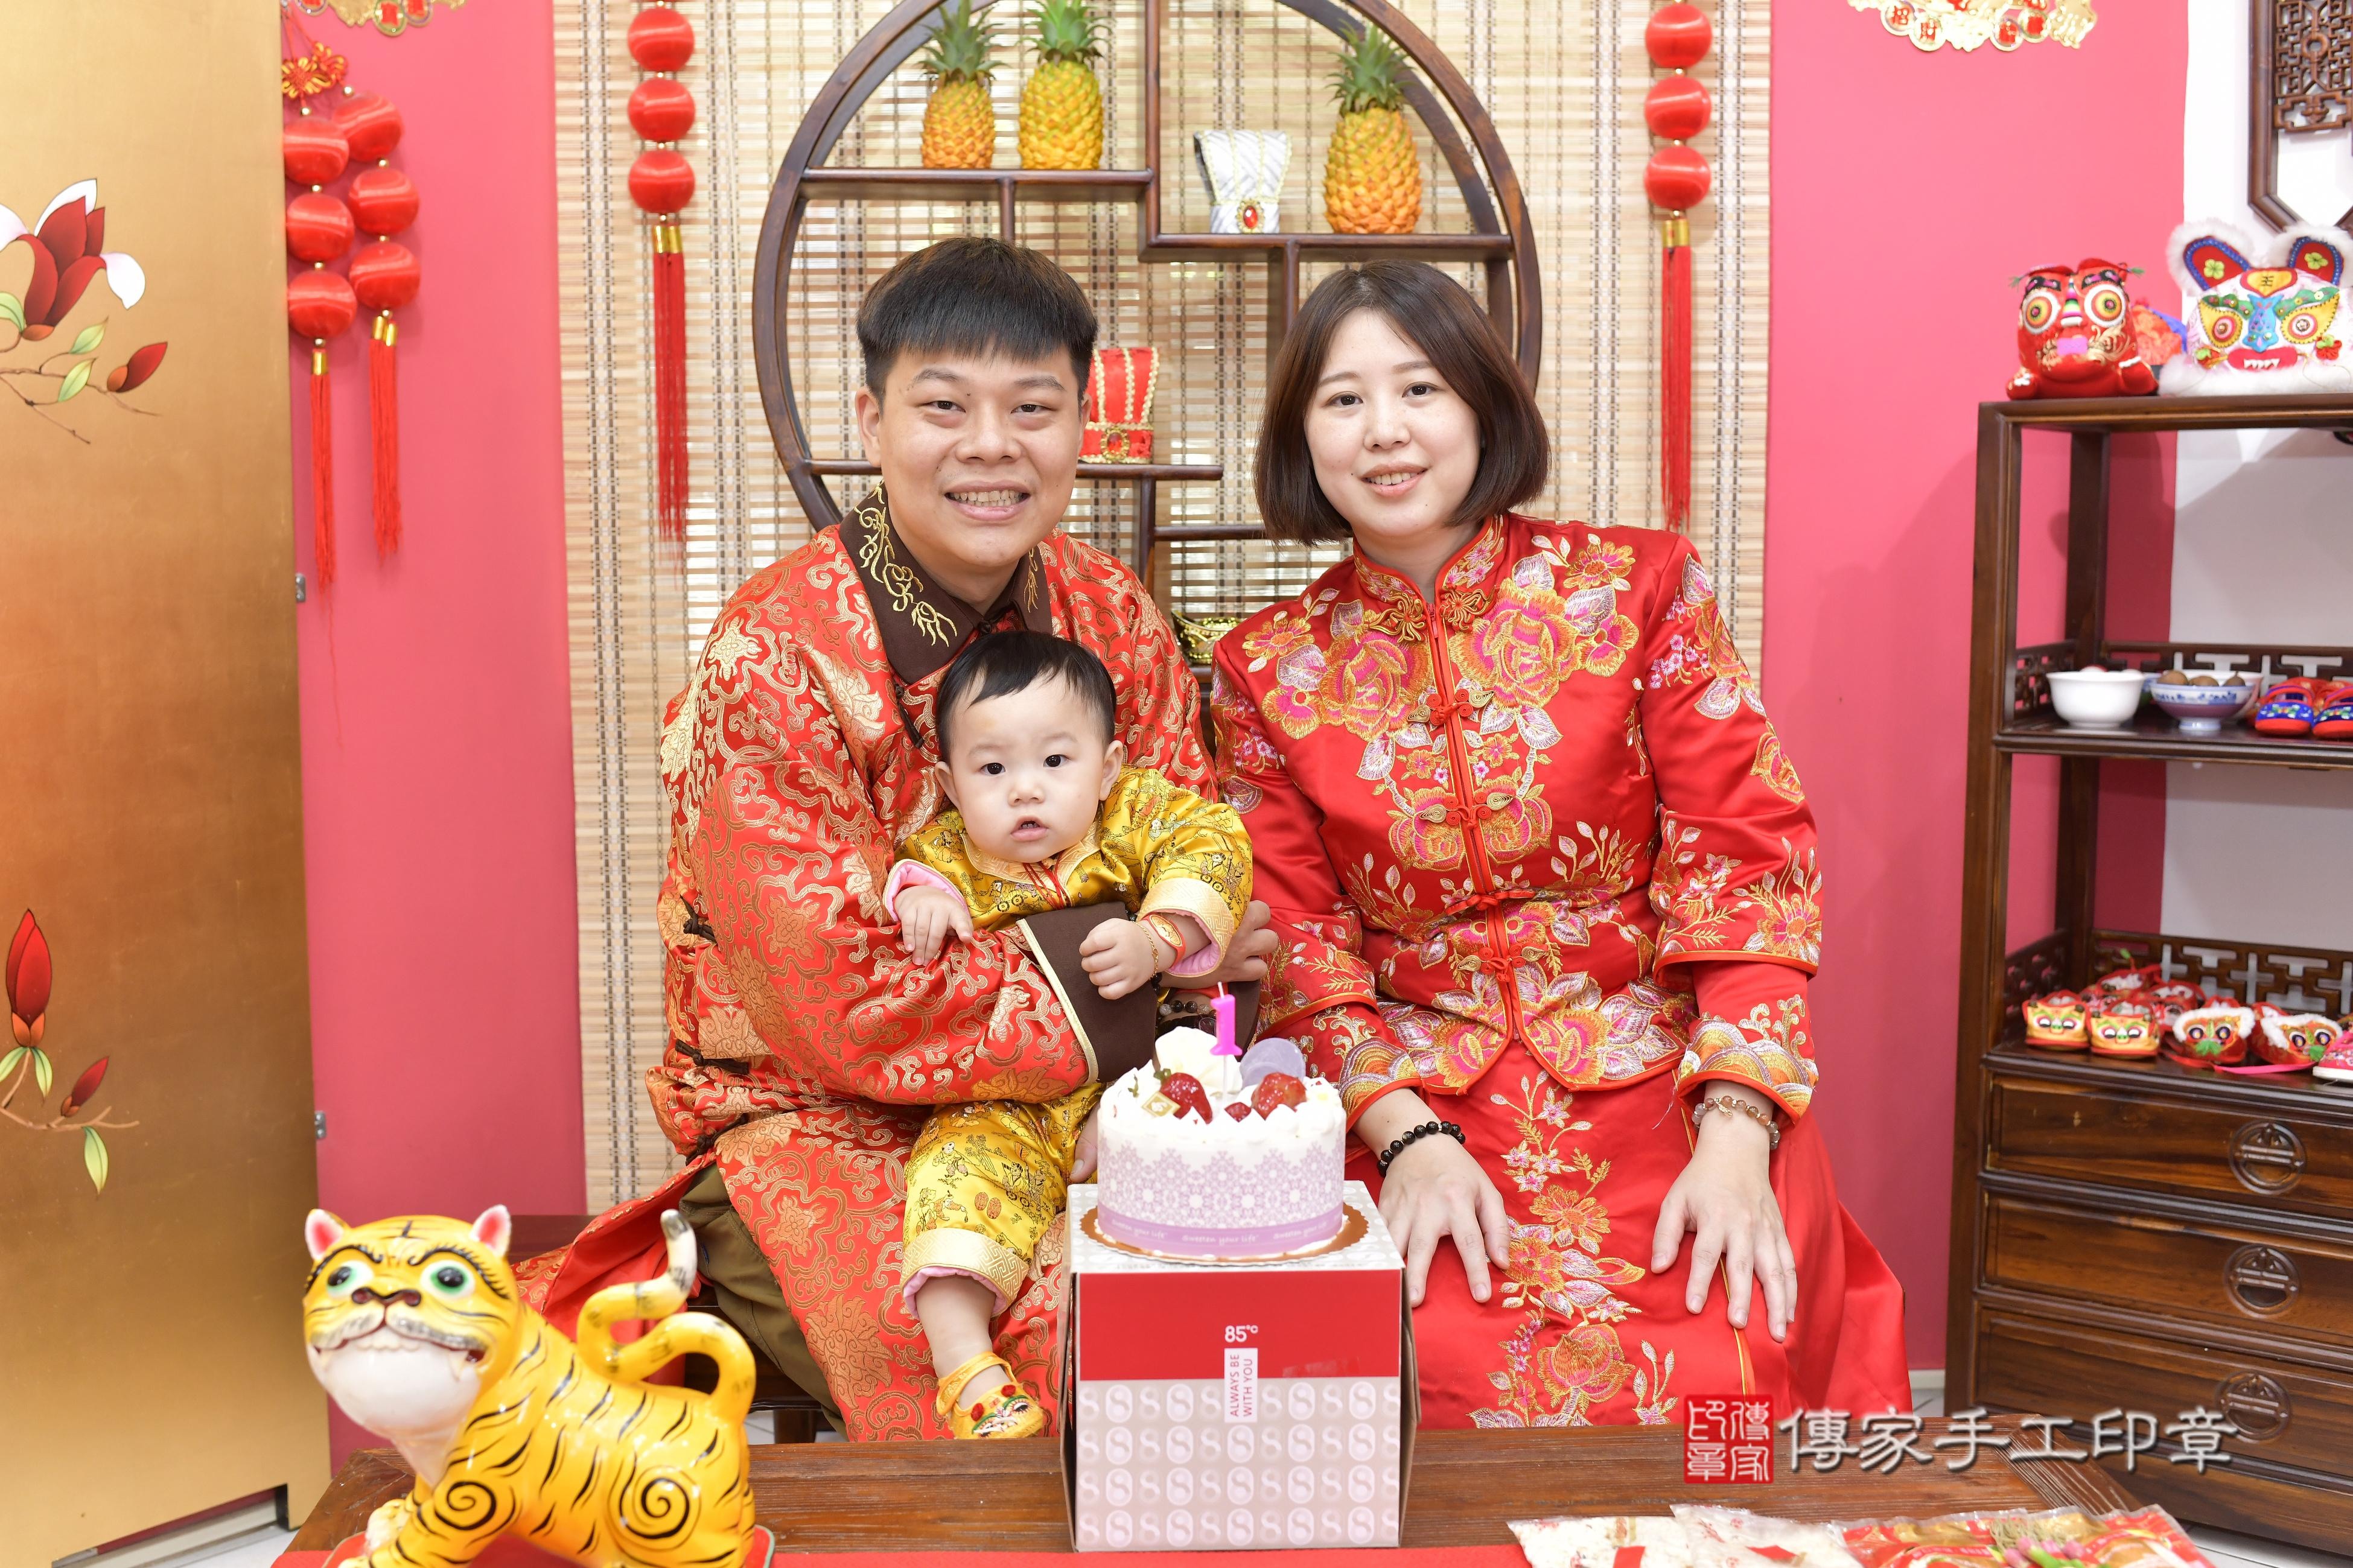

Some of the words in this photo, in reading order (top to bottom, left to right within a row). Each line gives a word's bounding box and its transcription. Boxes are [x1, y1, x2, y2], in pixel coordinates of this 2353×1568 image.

[1230, 1354, 1240, 1367] BE
[1243, 1359, 1252, 1383] YOU
[1230, 1371, 1240, 1417] ALWAYS
[1243, 1386, 1252, 1417] WITH
